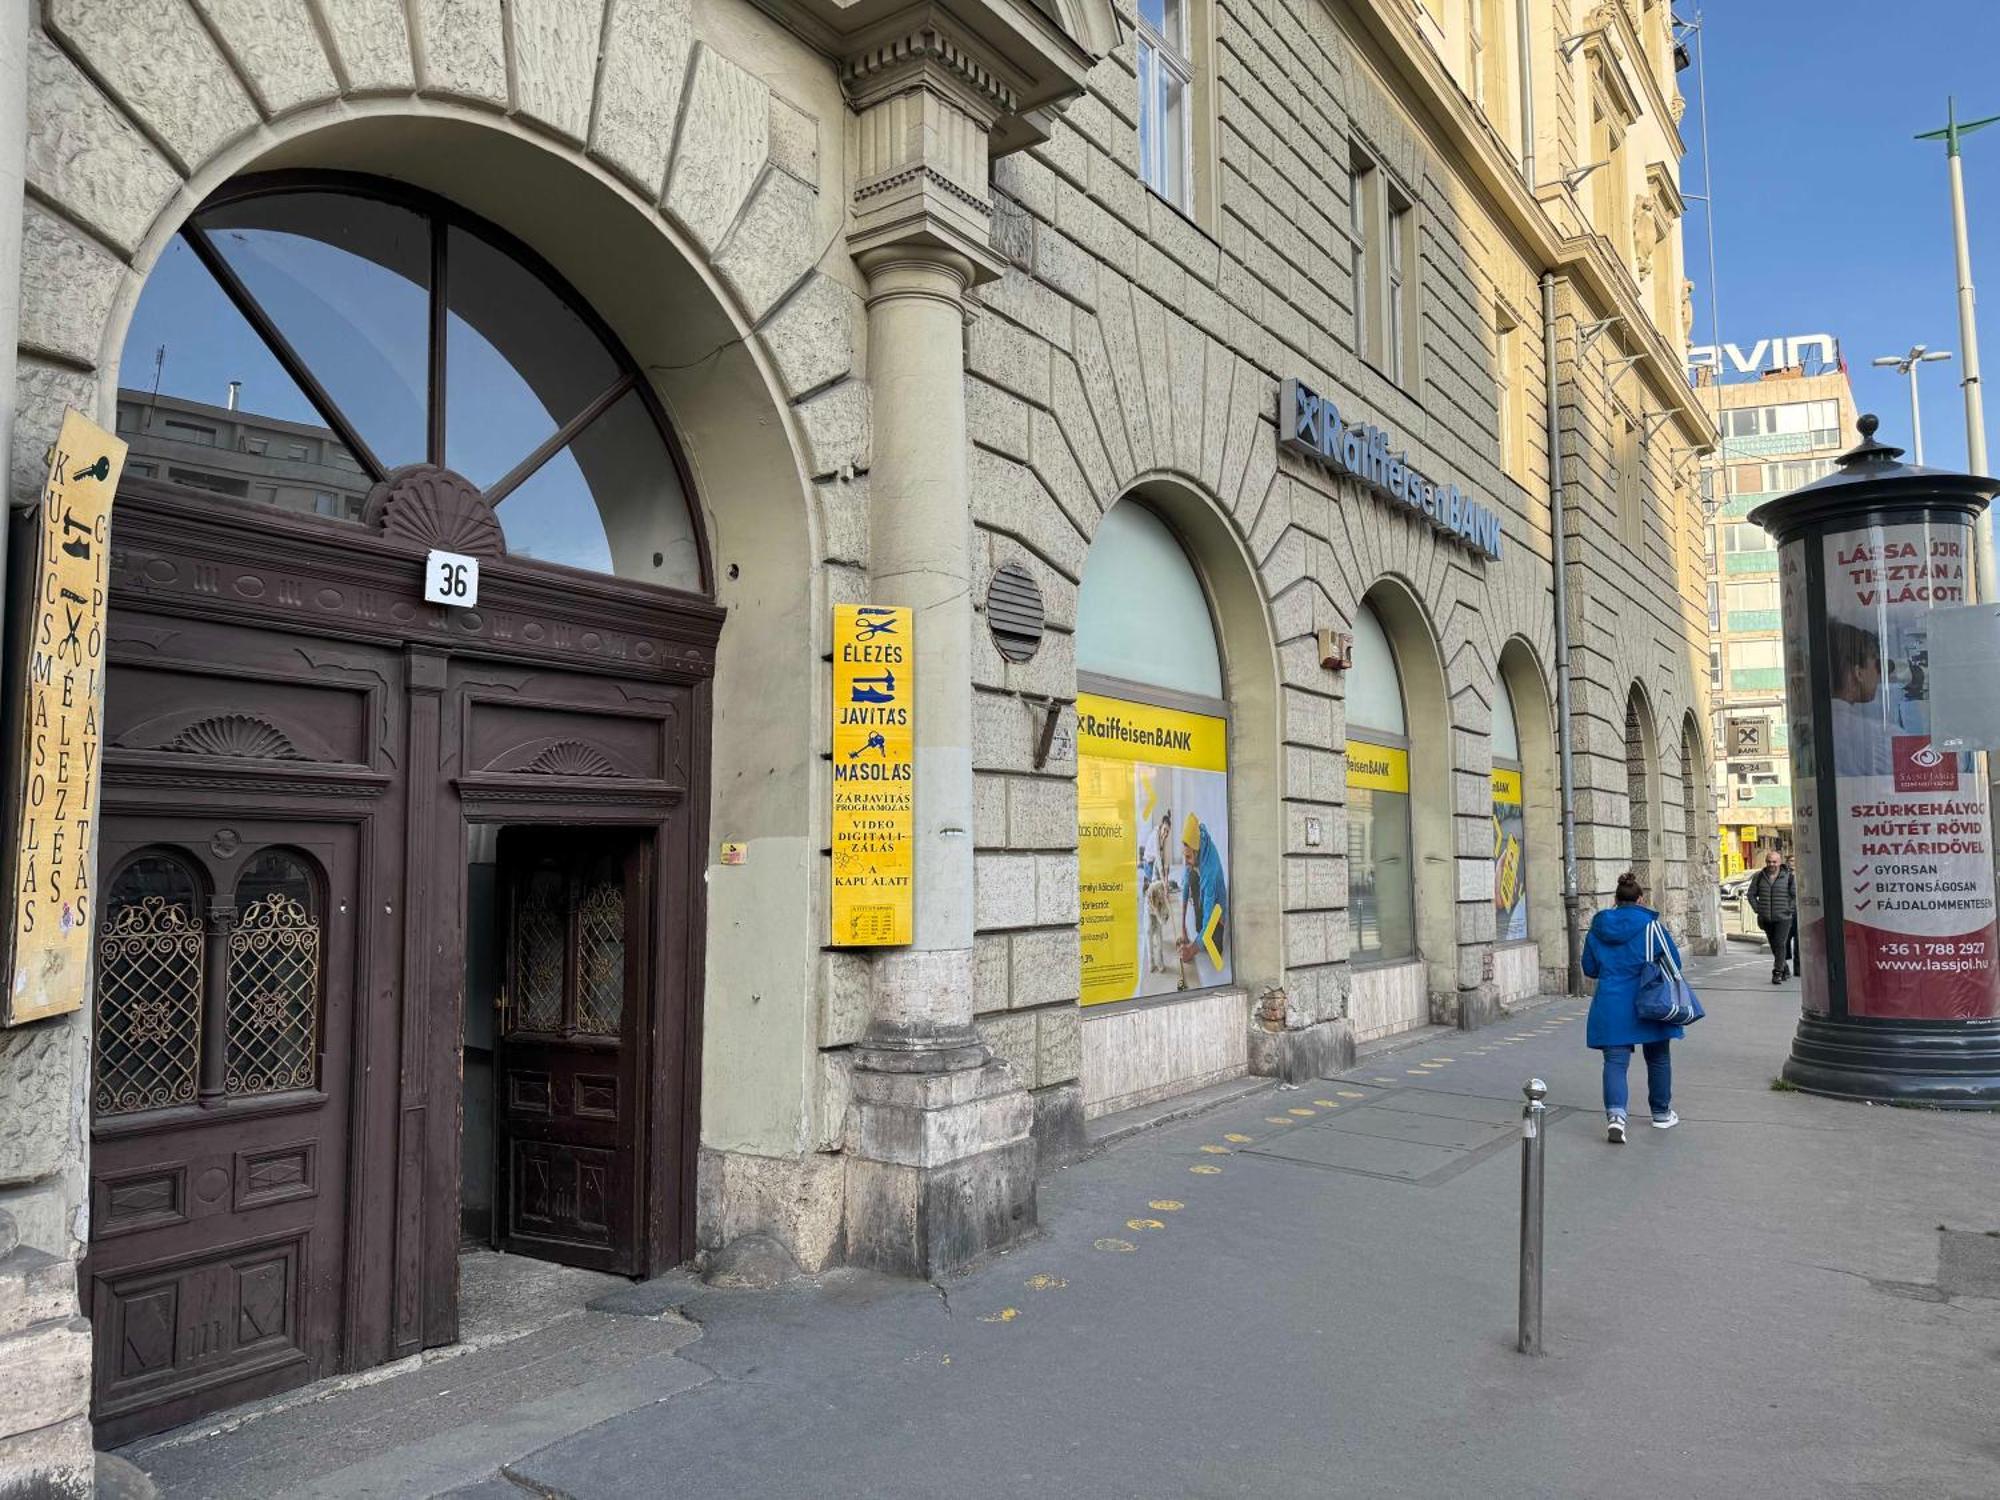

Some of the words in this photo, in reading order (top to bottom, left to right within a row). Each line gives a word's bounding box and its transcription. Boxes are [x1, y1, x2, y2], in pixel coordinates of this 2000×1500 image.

[1323, 398, 1504, 562] RaiffeisenBANK
[440, 563, 468, 597] 36
[844, 643, 903, 663] ÉLEZÉS
[840, 707, 907, 725] JAVÍTÁS
[1087, 714, 1192, 751] RaiffeisenBANK
[50, 670, 74, 903] ÉLEZÉS
[853, 820, 894, 830] VIDEO
[1937, 818, 1982, 835] RÖVID
[868, 865, 877, 874] A
[1875, 864, 1937, 875] GYORSAN
[835, 876, 867, 886] KAPU
[871, 876, 909, 886] ALATT
[1876, 879, 1976, 893] BIZTONSÁGOSAN
[1880, 943, 1910, 955] +36
[1913, 943, 1920, 955] 1
[1925, 943, 1955, 955] 788
[1959, 942, 1985, 954] 2927
[1876, 958, 1989, 973] www.lassjol.hu
